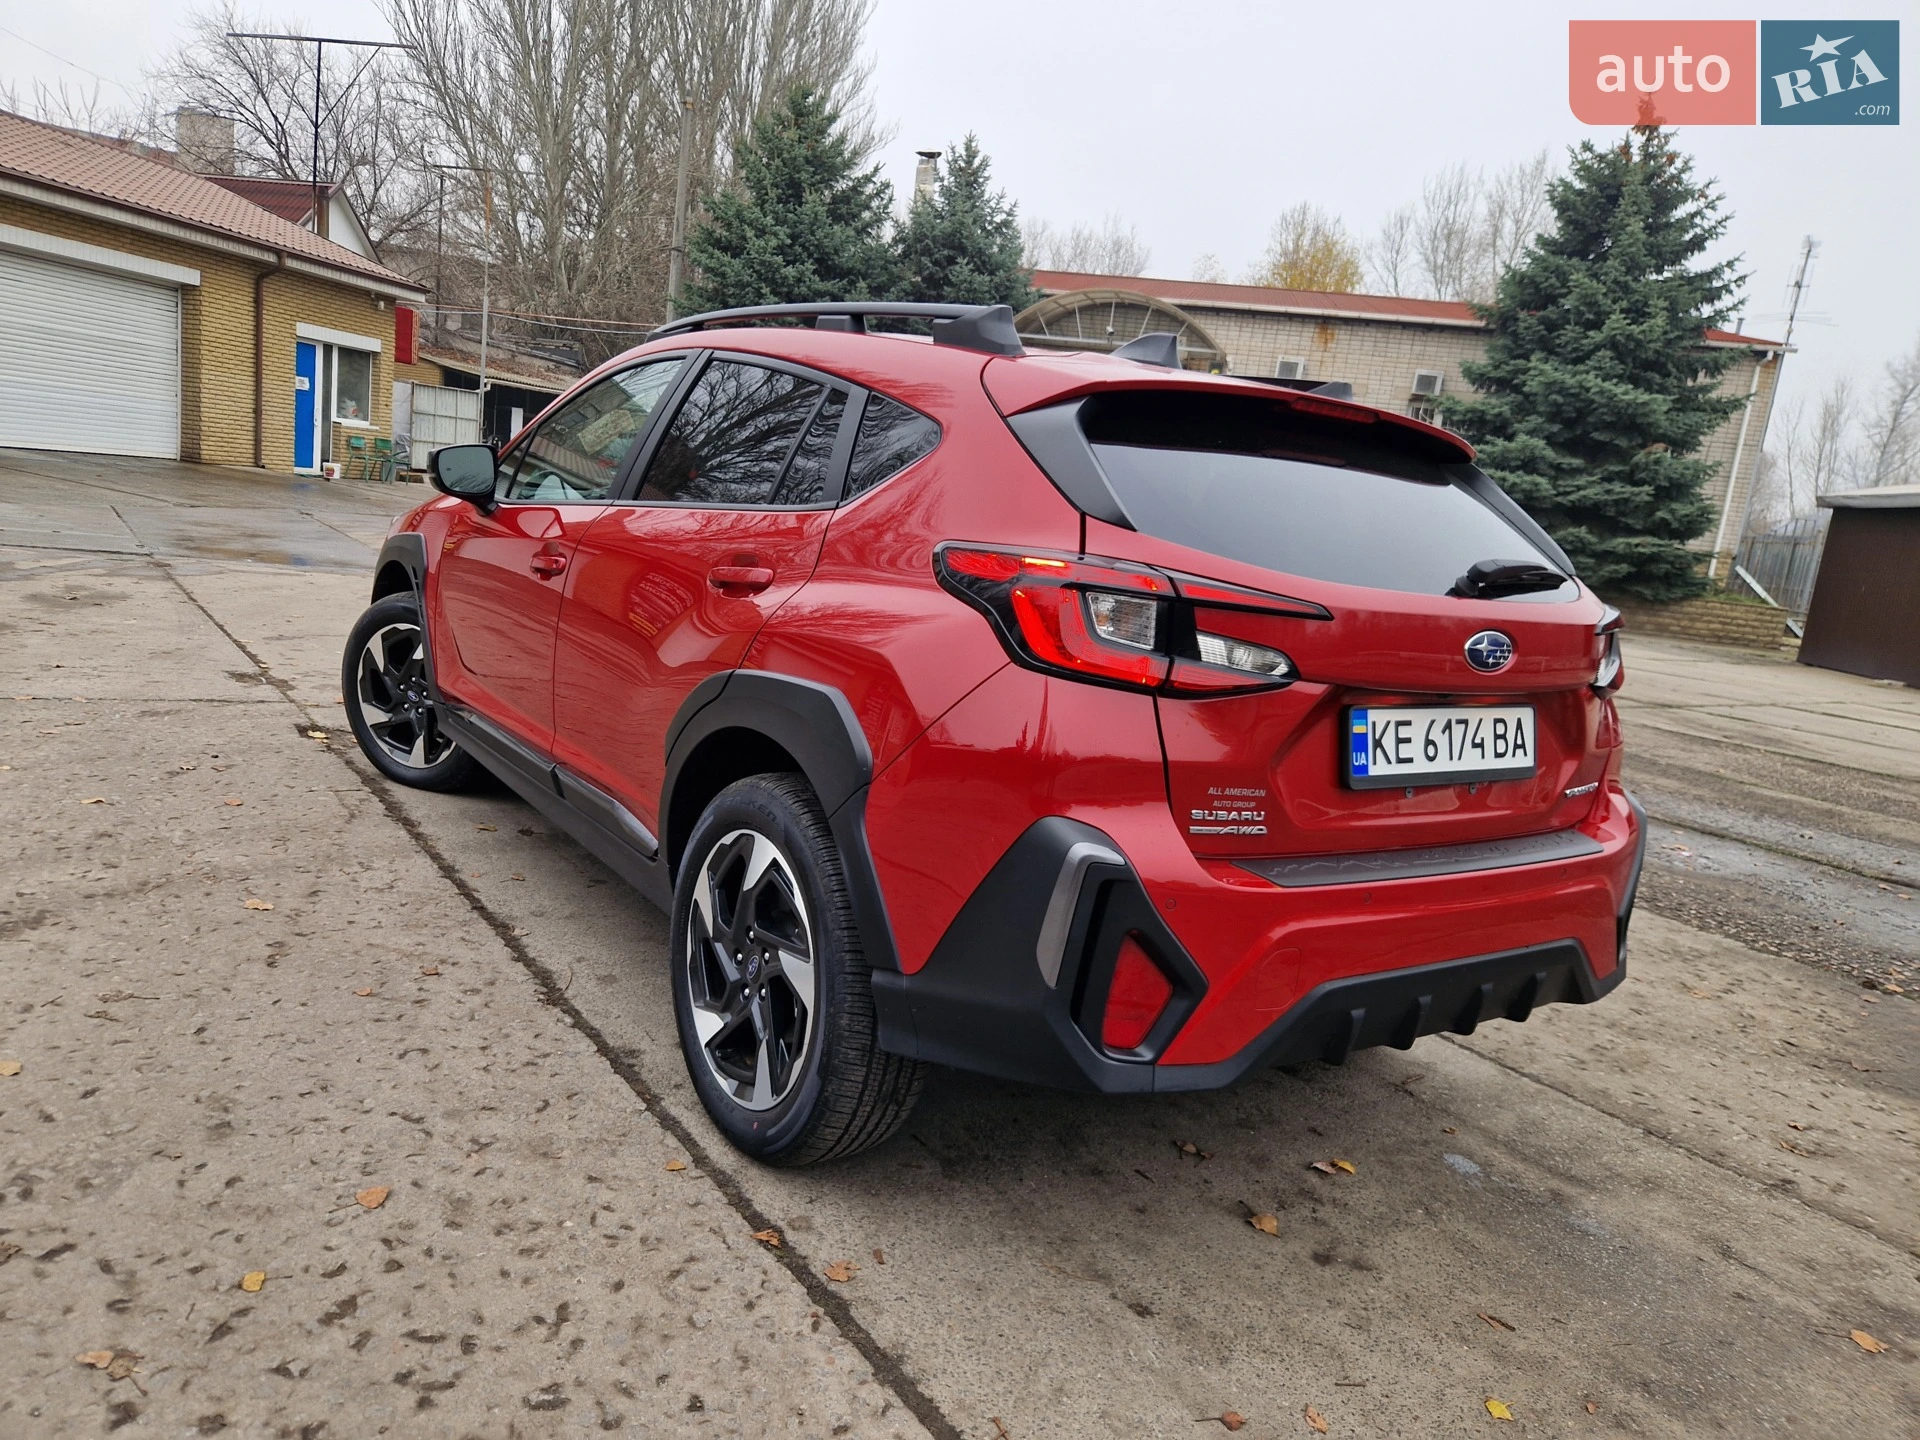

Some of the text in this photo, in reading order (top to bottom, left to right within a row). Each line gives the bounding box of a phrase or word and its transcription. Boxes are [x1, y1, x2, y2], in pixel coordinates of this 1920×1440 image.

[1371, 717, 1528, 766] KE 6174 BA
[1352, 751, 1368, 766] UA
[1208, 787, 1266, 796] ALL AMERICAN
[1191, 810, 1265, 820] SUBARU
[1219, 826, 1267, 834] AWD
